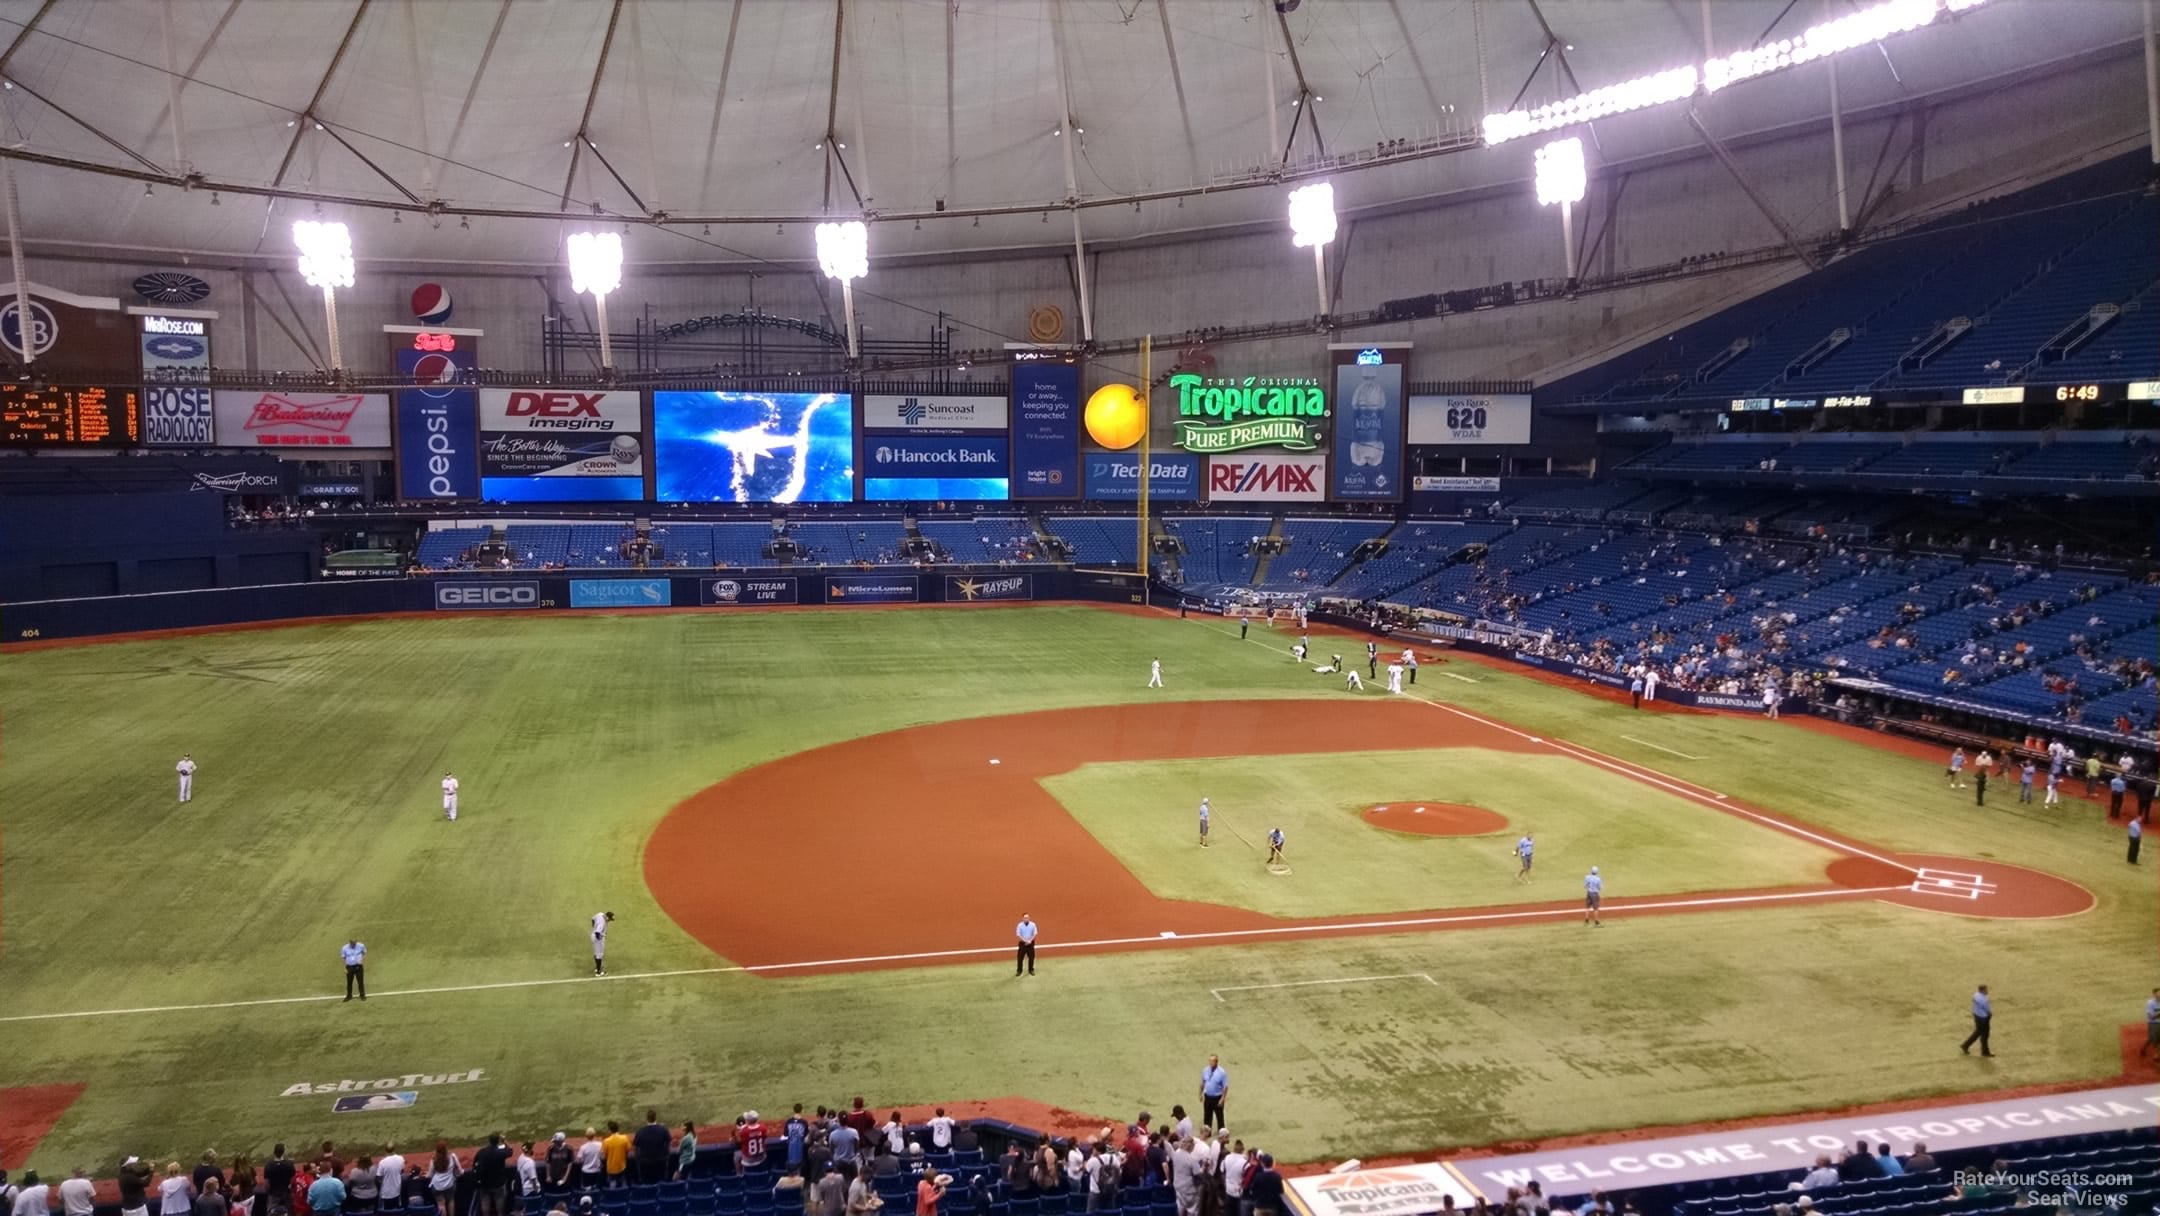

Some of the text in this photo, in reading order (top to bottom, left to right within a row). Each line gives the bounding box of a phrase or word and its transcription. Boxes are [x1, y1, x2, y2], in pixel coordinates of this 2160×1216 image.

[1169, 374, 1324, 420] Tropicana
[2056, 385, 2099, 400] 6:49
[146, 388, 211, 417] ROSE
[506, 392, 606, 417] DEX
[929, 403, 974, 413] Suncoast
[1023, 402, 1053, 410] keeping
[256, 403, 353, 420] Budweiser
[1448, 408, 1487, 429] 620
[147, 417, 211, 442] RADIOLOGY
[529, 417, 614, 430] imaging
[1186, 424, 1304, 448] PURE PREMIUM
[421, 408, 457, 496] pepsi
[894, 449, 996, 462] Hancock Bank
[1150, 464, 1187, 478] Data
[1212, 462, 1317, 493] RE/MAX
[241, 476, 277, 485] PORCH
[439, 587, 536, 604] GEICO
[579, 583, 636, 599] Sagicor
[757, 591, 776, 599] LIVE
[21, 629, 39, 637] 404
[1698, 696, 1743, 706] RAYMOND
[280, 1069, 485, 1096] AstroTurf
[748, 1138, 763, 1155] 81
[1482, 1101, 2145, 1187] WELCOME TO TROPICANA
[1318, 1181, 1439, 1203] Tropicana
